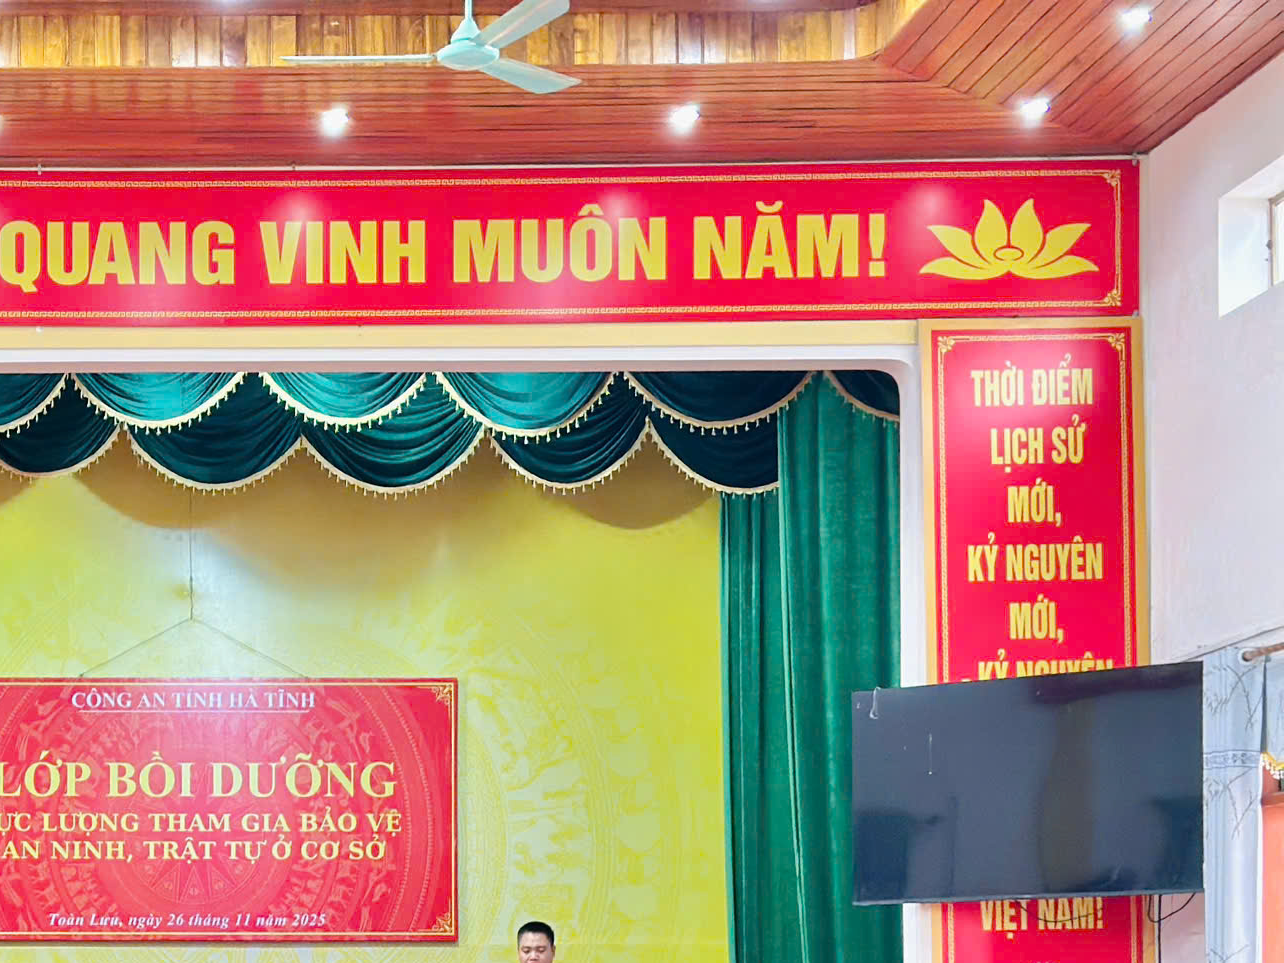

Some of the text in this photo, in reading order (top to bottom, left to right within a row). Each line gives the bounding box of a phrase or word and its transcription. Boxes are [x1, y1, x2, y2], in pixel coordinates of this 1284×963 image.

[259, 219, 426, 285] VINH
[453, 203, 667, 283] MUÔN
[693, 200, 886, 280] NĂM!
[970, 353, 1094, 407] THỜI ĐIỂM
[990, 413, 1087, 473] LỊCH SỬ
[1007, 477, 1063, 527] MỚI,
[967, 532, 1104, 583] KỶ NGUYÊN
[1009, 593, 1065, 644] MỚI,
[71, 687, 133, 709] CÔNG
[137, 692, 166, 709] AN
[264, 687, 315, 709] TĨNH
[107, 751, 195, 799] BỒI
[212, 752, 398, 799] DƯỠNG
[42, 812, 140, 837] LƯỢNG
[148, 812, 231, 833] THAM
[241, 812, 292, 834] GIA
[299, 806, 358, 834] BẢO
[365, 808, 403, 837] VỆ
[2, 834, 387, 864] AN NINH, TRẬT TỰ Ở CƠ SỞ
[49, 912, 84, 926] Toàn
[128, 912, 163, 929] ngày
[167, 913, 185, 926] 26
[188, 911, 230, 929] tháng
[235, 913, 250, 926] 11
[255, 914, 287, 926] năm
[291, 913, 326, 927] 2025
[1038, 897, 1104, 930] NAM!
